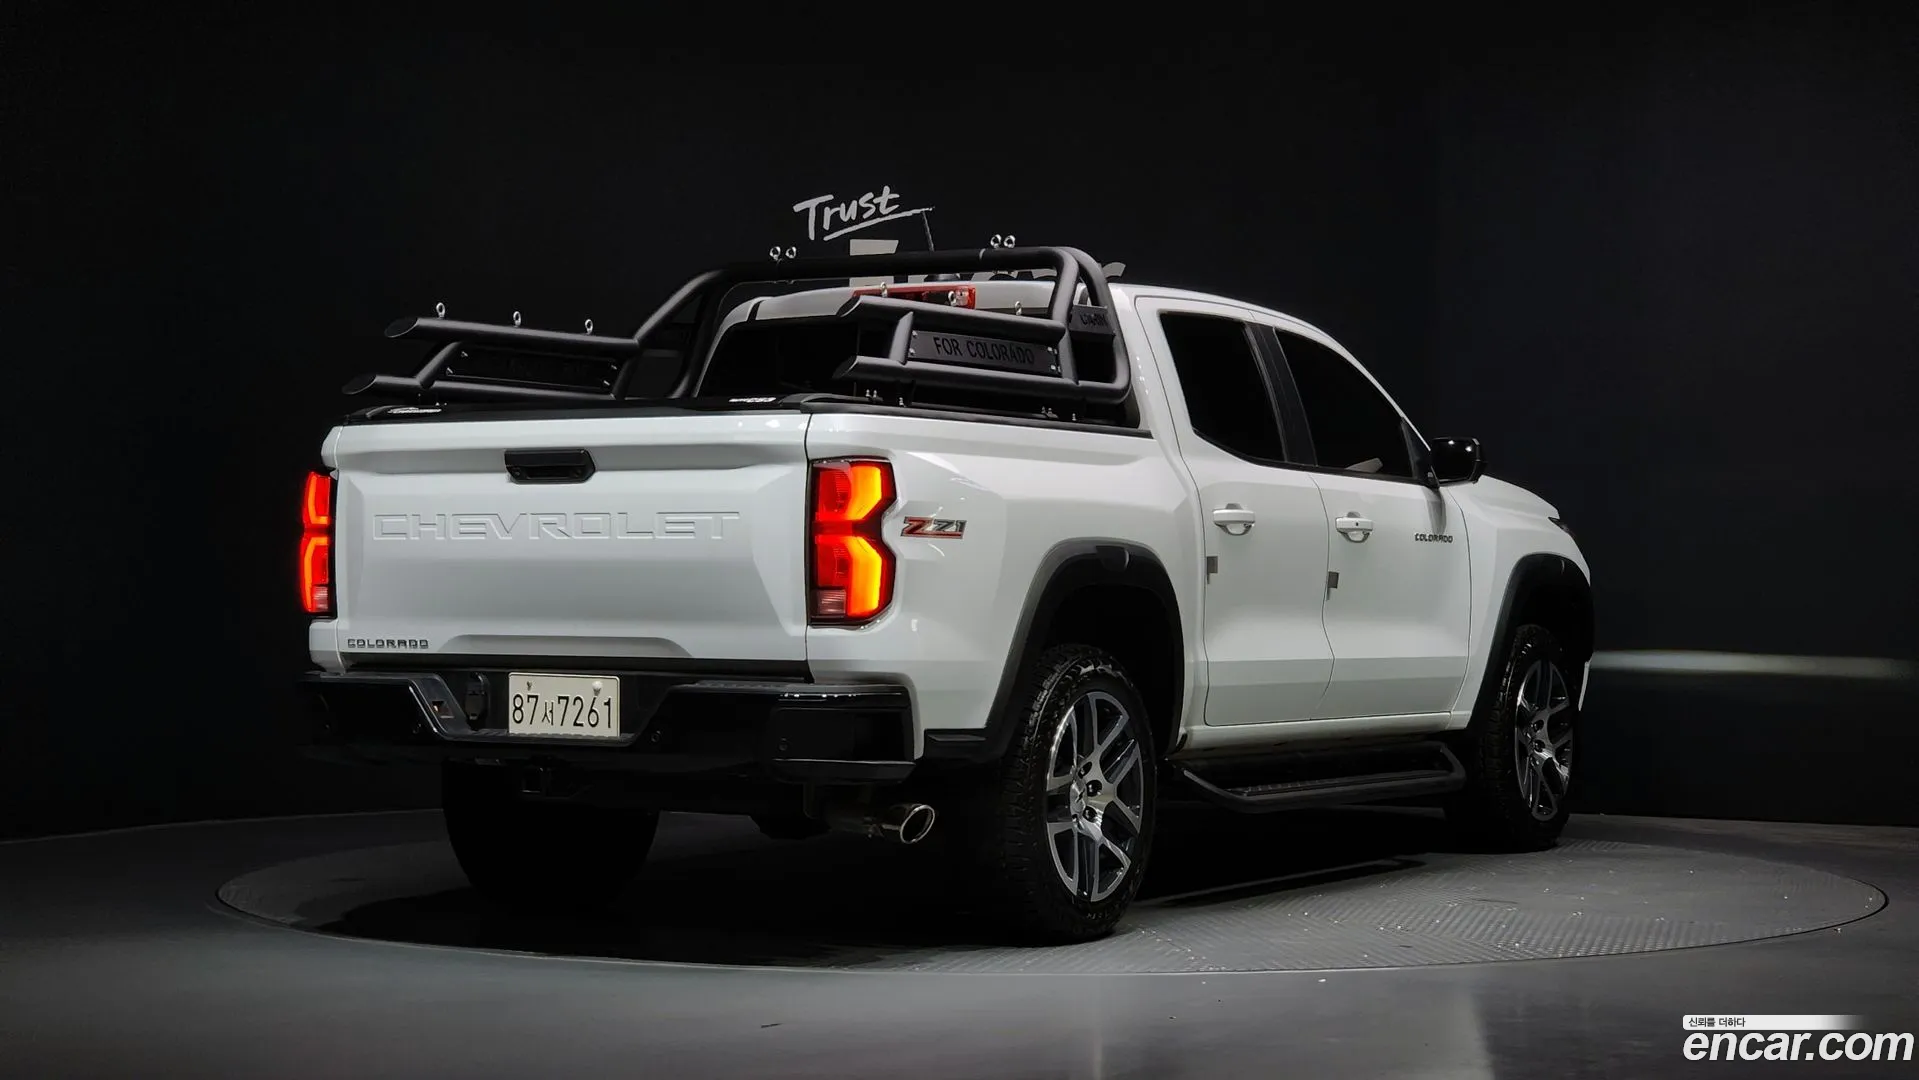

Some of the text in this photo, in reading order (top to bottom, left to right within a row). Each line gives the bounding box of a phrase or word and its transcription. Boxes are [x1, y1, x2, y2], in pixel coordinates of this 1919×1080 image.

[793, 185, 901, 241] Trust
[933, 337, 1035, 364] FOR COLORADO
[372, 511, 740, 541] CHEVROLET
[900, 516, 967, 540] Z71
[1414, 533, 1453, 543] COLORADO
[347, 638, 429, 649] COLORADO
[512, 693, 612, 729] 87서7261
